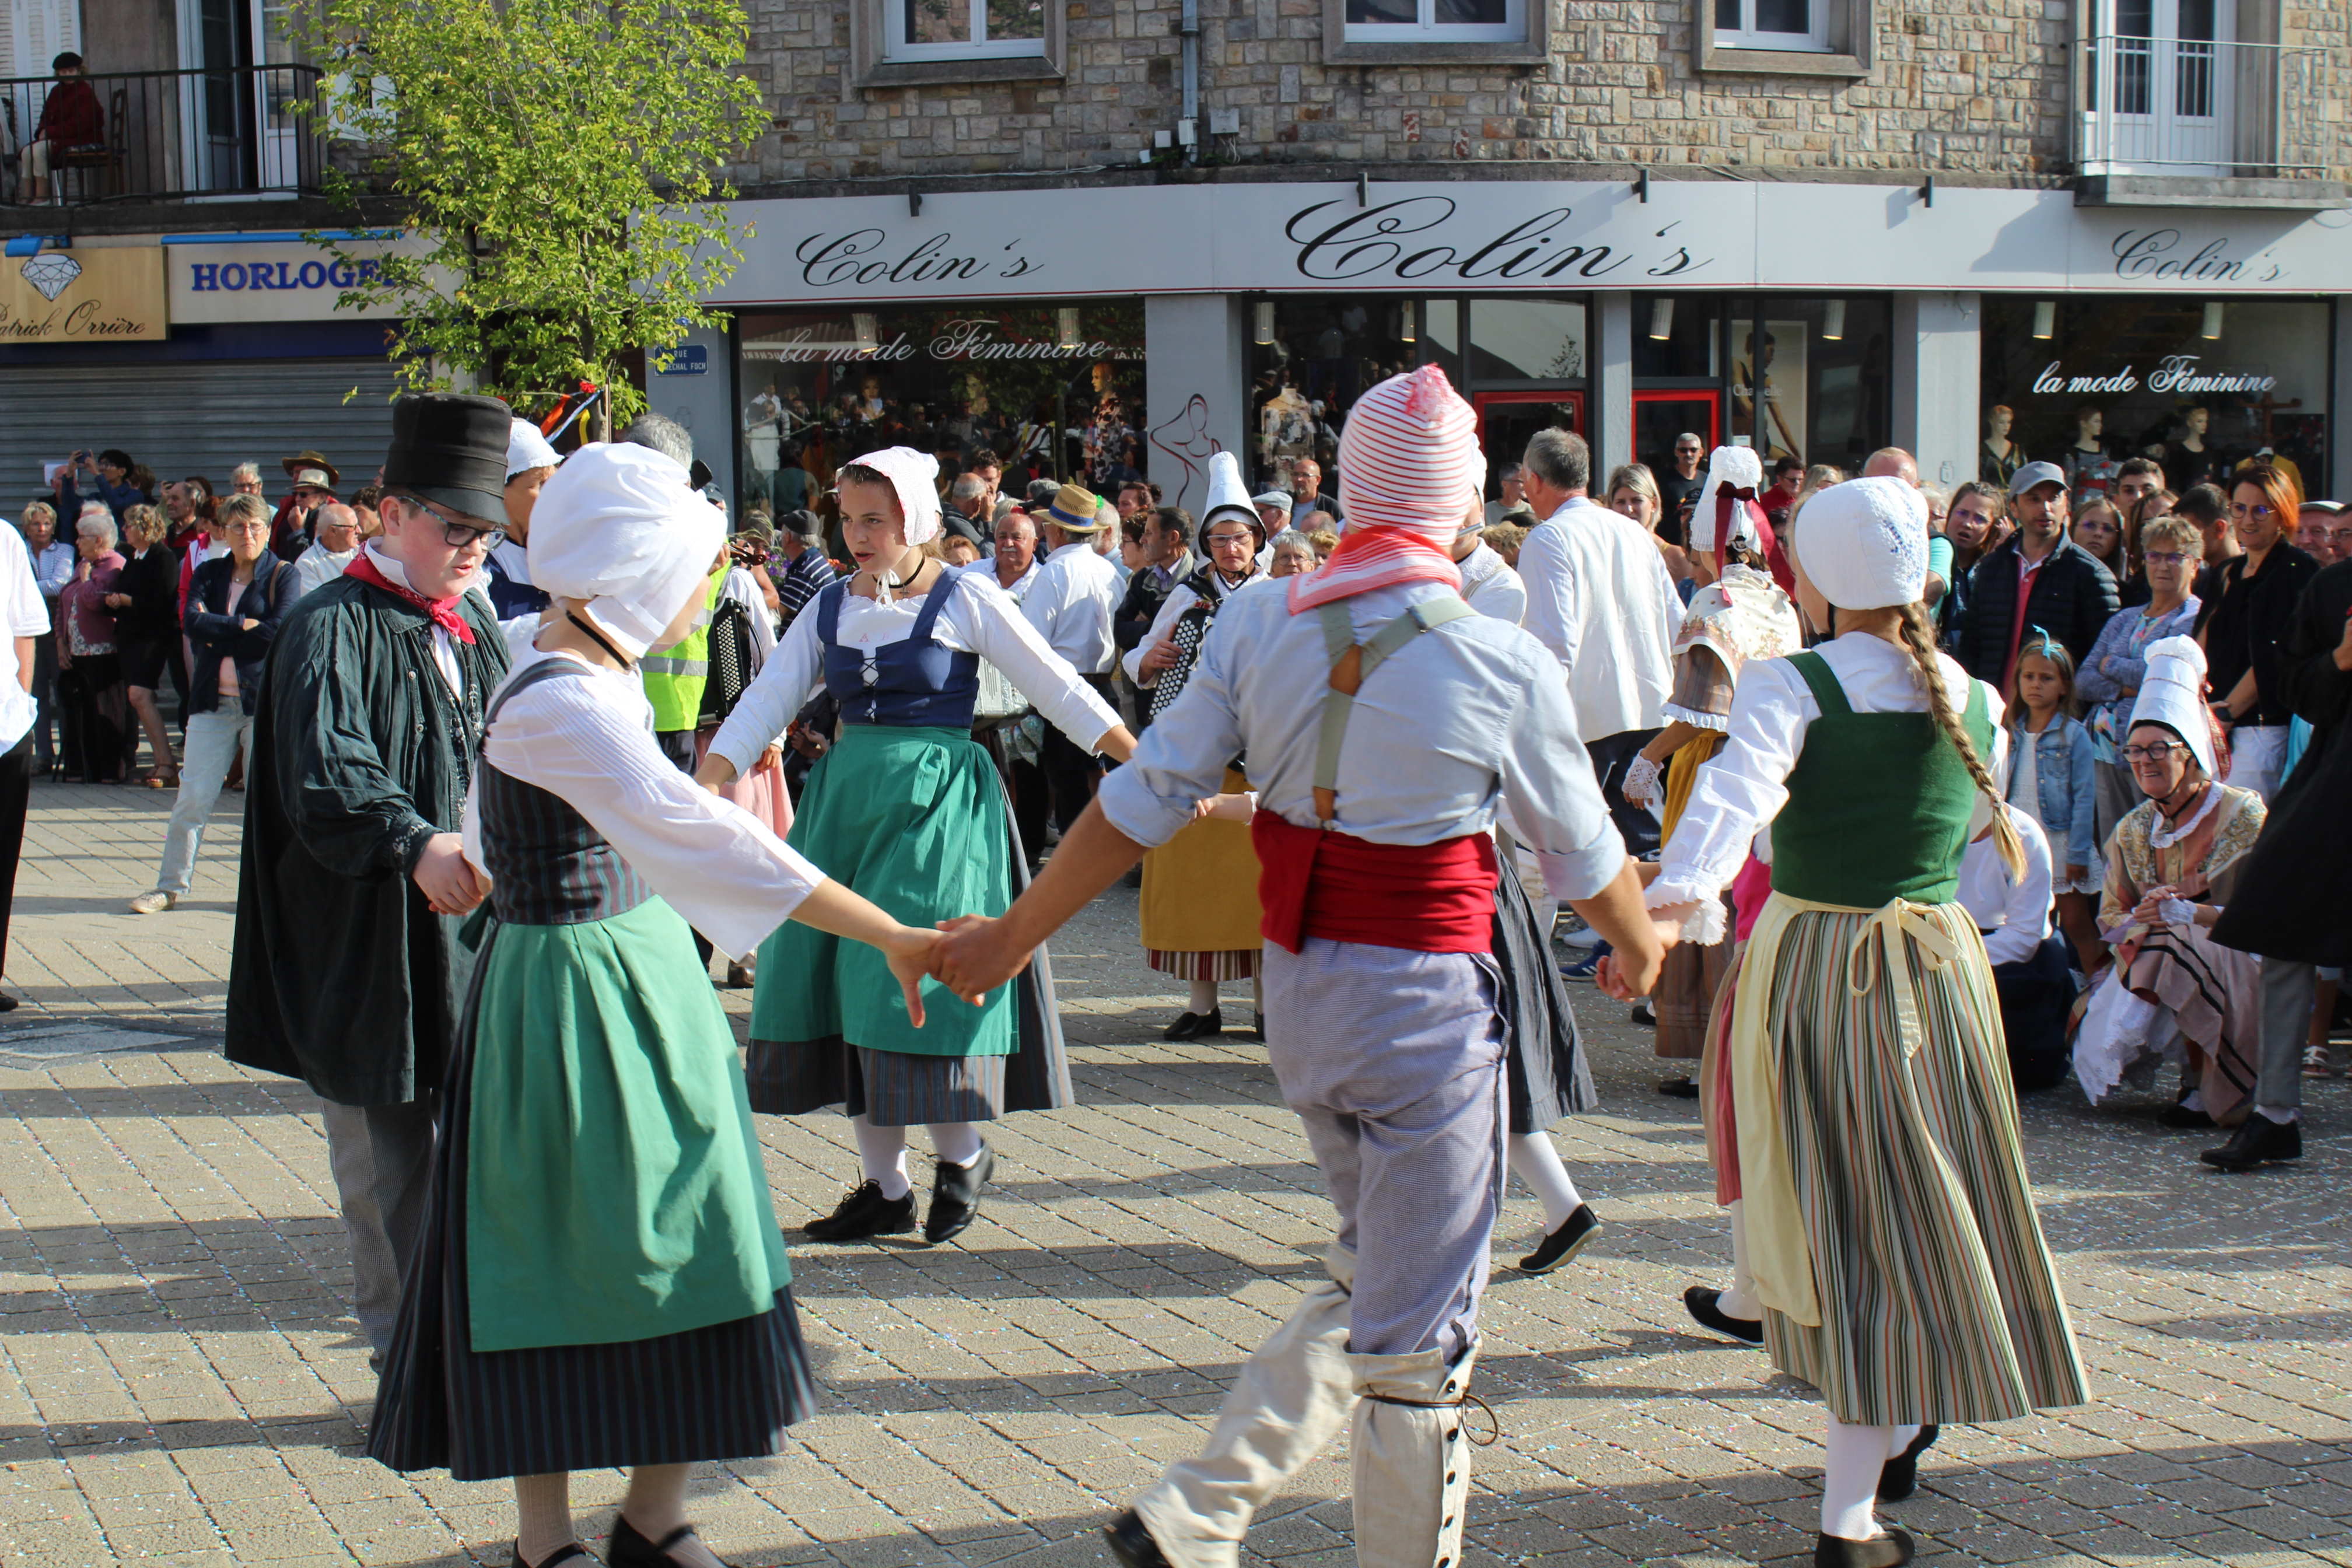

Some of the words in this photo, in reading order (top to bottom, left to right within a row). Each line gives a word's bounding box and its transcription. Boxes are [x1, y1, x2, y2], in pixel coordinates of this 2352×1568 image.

[796, 228, 1044, 286] Colin's
[1285, 196, 1714, 279] Colin's
[2112, 229, 2290, 282] Colin's
[65, 299, 145, 335] Orrière
[779, 328, 817, 362] la
[824, 332, 916, 362] mode
[929, 319, 1111, 360] Féminine
[2033, 361, 2066, 394] la
[2067, 365, 2139, 393] mode
[2148, 355, 2277, 393] Féminine
